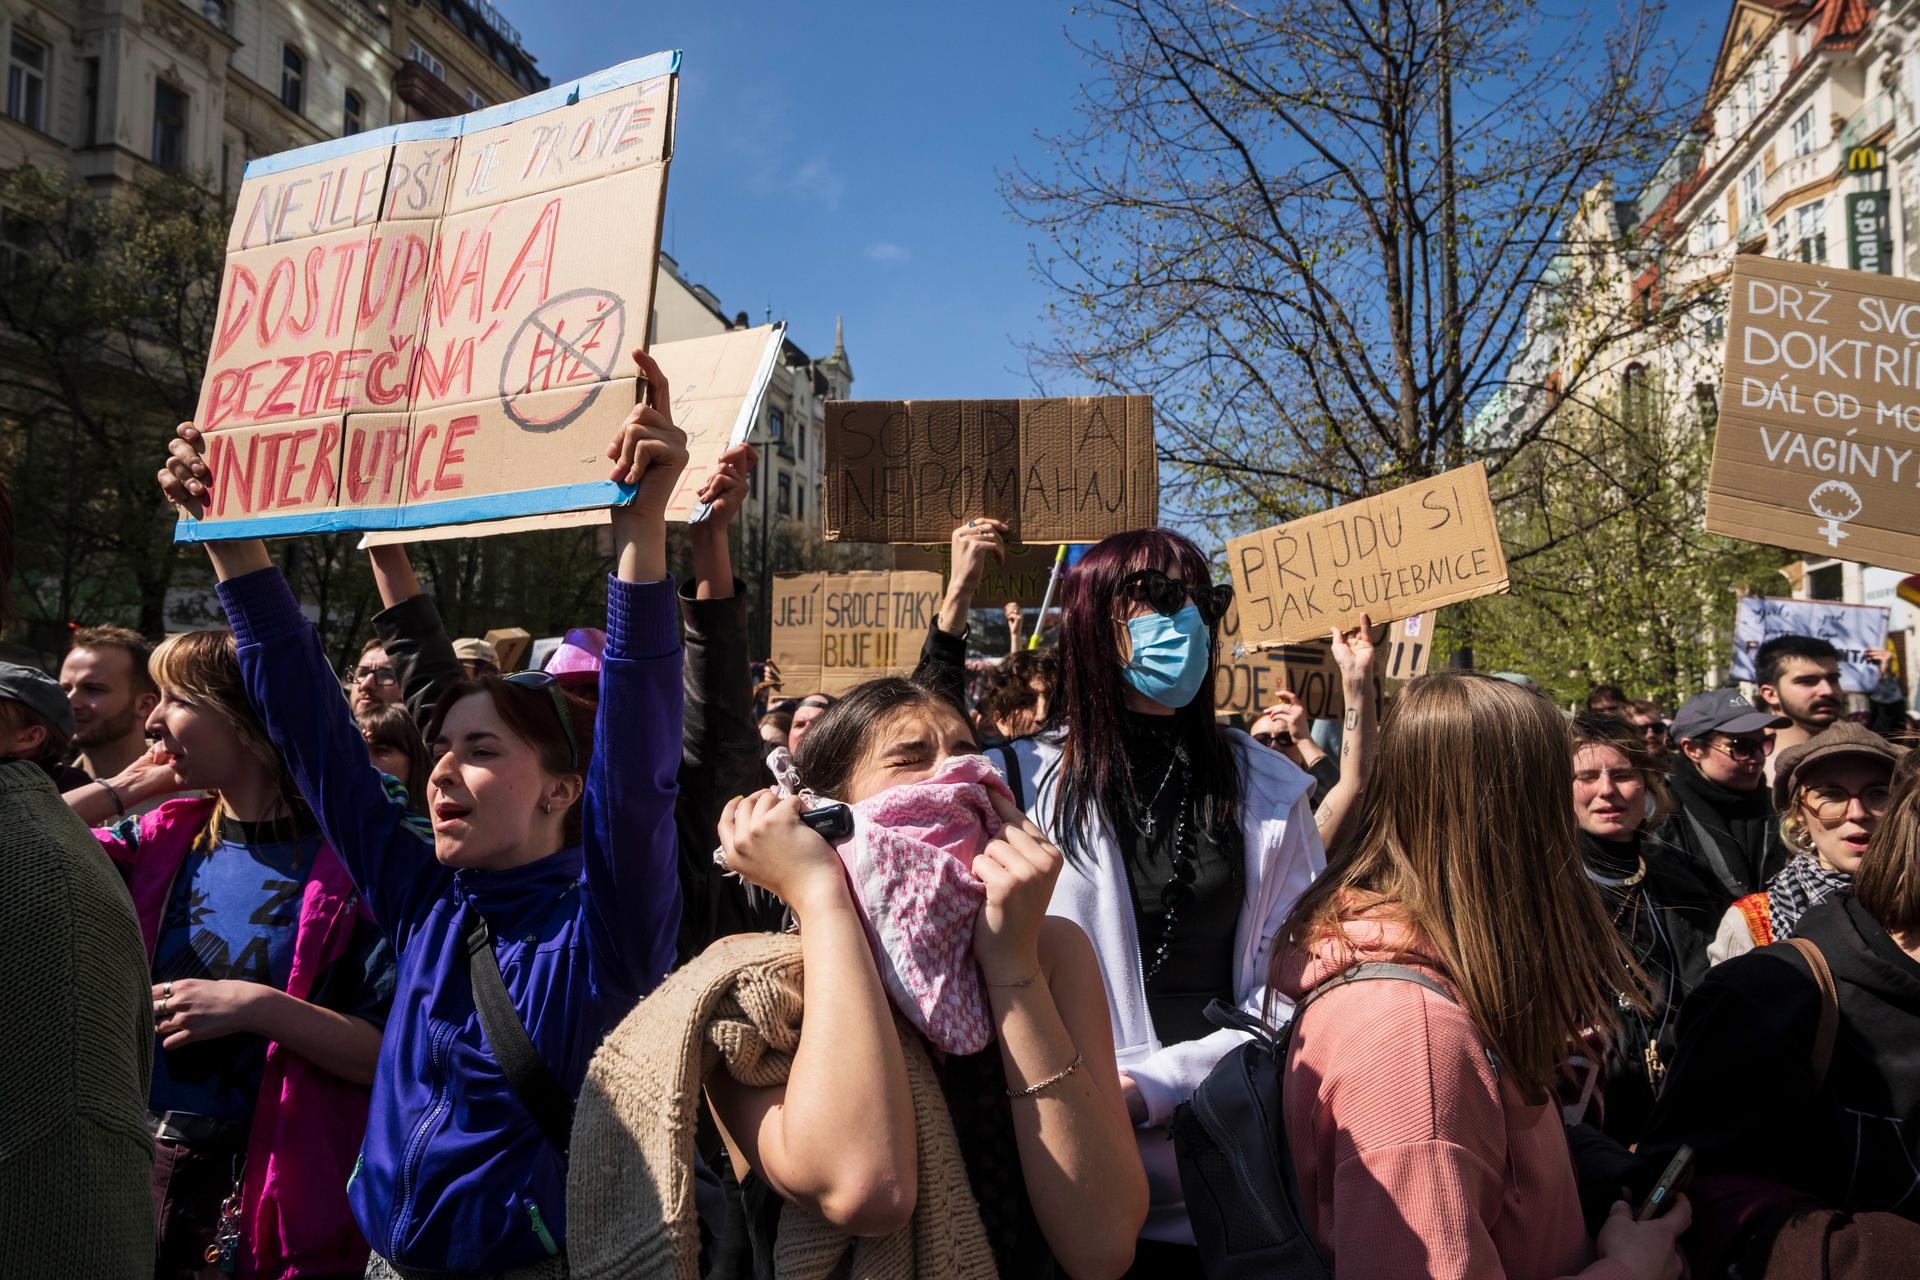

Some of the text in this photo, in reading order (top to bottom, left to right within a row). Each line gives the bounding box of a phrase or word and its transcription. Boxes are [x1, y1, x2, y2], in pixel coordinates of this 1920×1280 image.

[241, 147, 457, 250] NEJLEPŠÍ
[466, 138, 510, 197] JE
[1854, 198, 1880, 273] nald's
[210, 197, 562, 364] DOSTUPNÁ A
[1748, 279, 1833, 325] DRŽ
[203, 319, 503, 432] BEZPEČNÁ
[1744, 326, 1920, 390] DOKTRÍ
[1741, 373, 1806, 415] DÁL
[1813, 390, 1861, 420] OD
[1077, 404, 1121, 454] A
[843, 443, 1145, 526] NEPOMÁHAJÍ
[1421, 485, 1465, 531] SI
[774, 583, 940, 629] JEJÍ SRDCE TAKY
[1250, 584, 1324, 632] JAK
[1216, 664, 1270, 713] OJE
